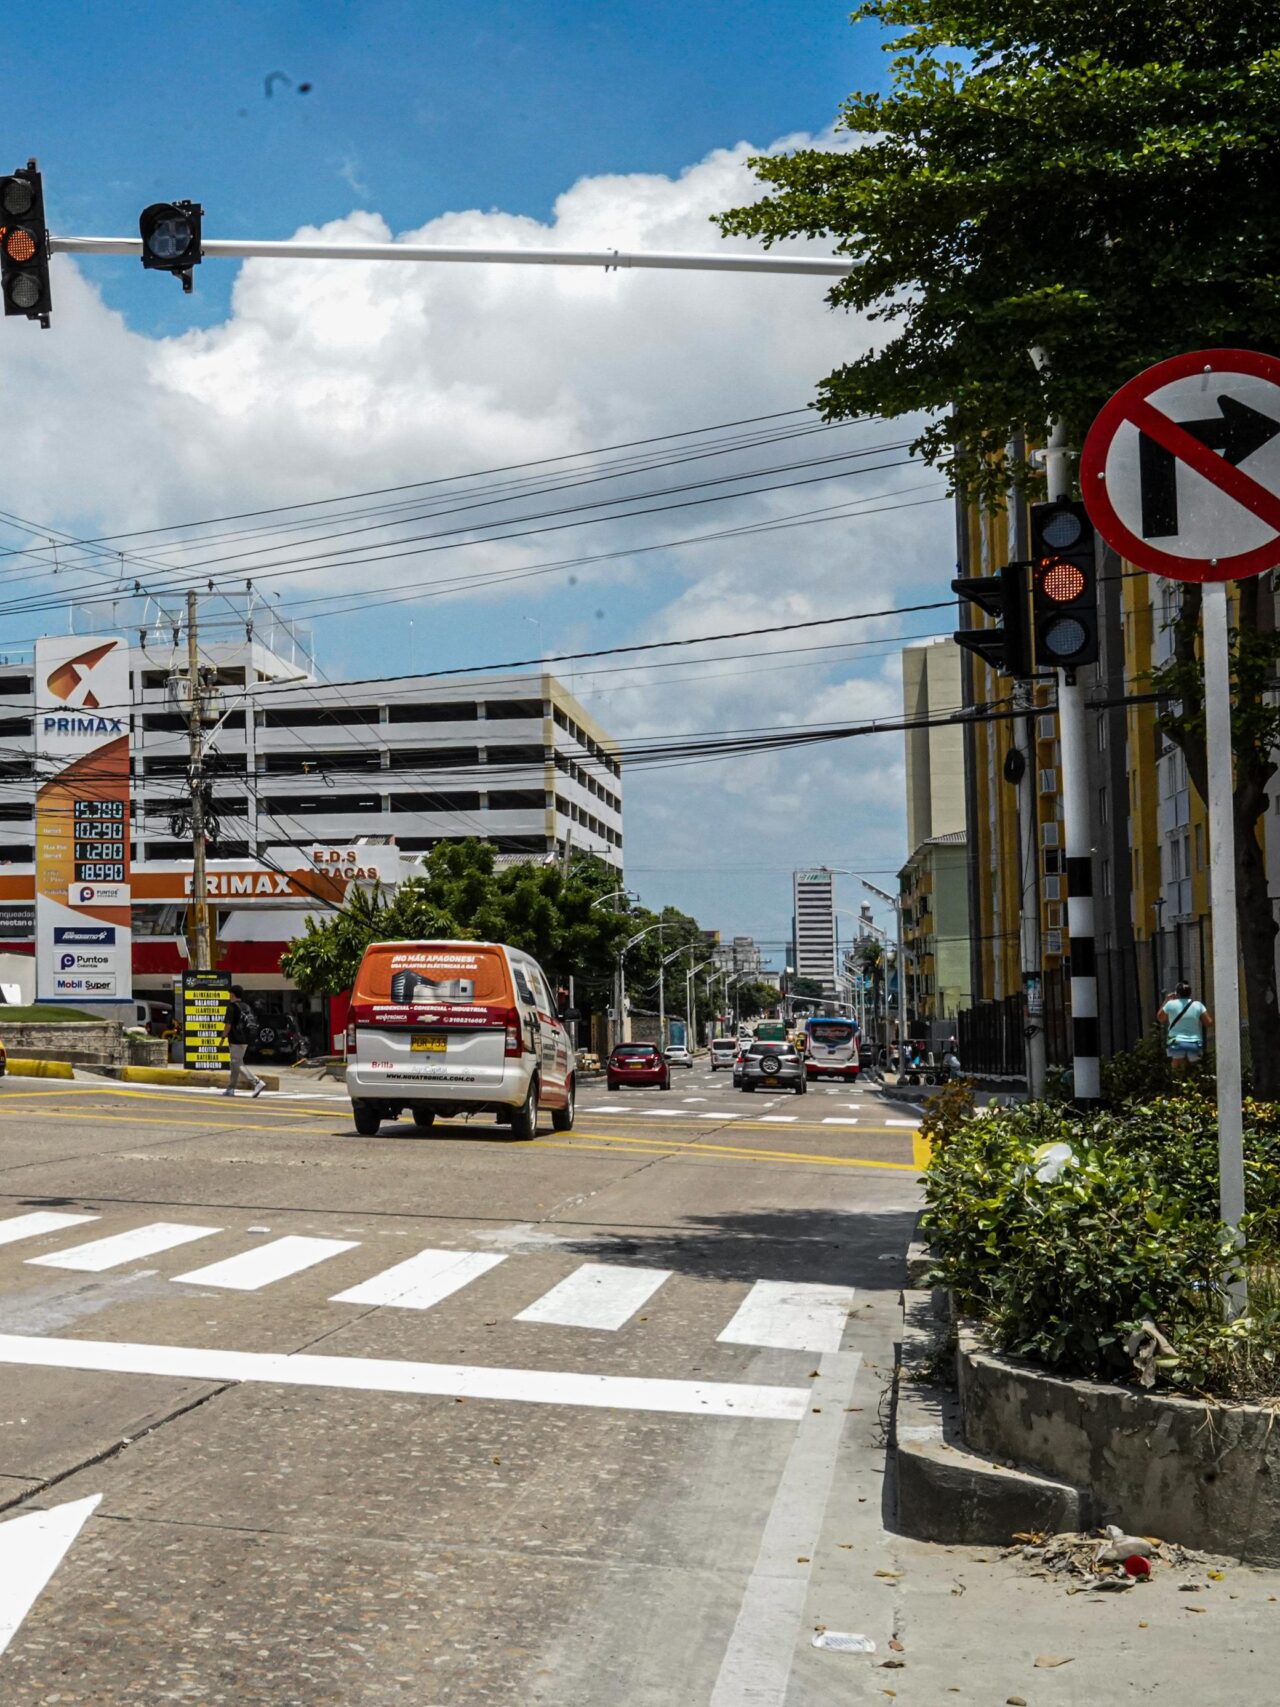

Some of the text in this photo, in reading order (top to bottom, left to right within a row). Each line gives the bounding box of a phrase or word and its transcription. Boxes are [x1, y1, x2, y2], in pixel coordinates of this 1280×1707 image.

[44, 717, 122, 733] PRIMAX
[75, 822, 123, 838] 10.290
[75, 843, 123, 859] 11.280
[313, 851, 357, 863] E.D.S
[81, 864, 123, 880] 18.990
[296, 868, 377, 879] RACAS
[184, 875, 293, 895] PRIMAX
[77, 955, 109, 963] Puntos
[407, 954, 426, 962] MÁS
[426, 955, 475, 963] APAGONES!
[57, 980, 111, 990] Mobil Super
[372, 1061, 394, 1069] Brilla
